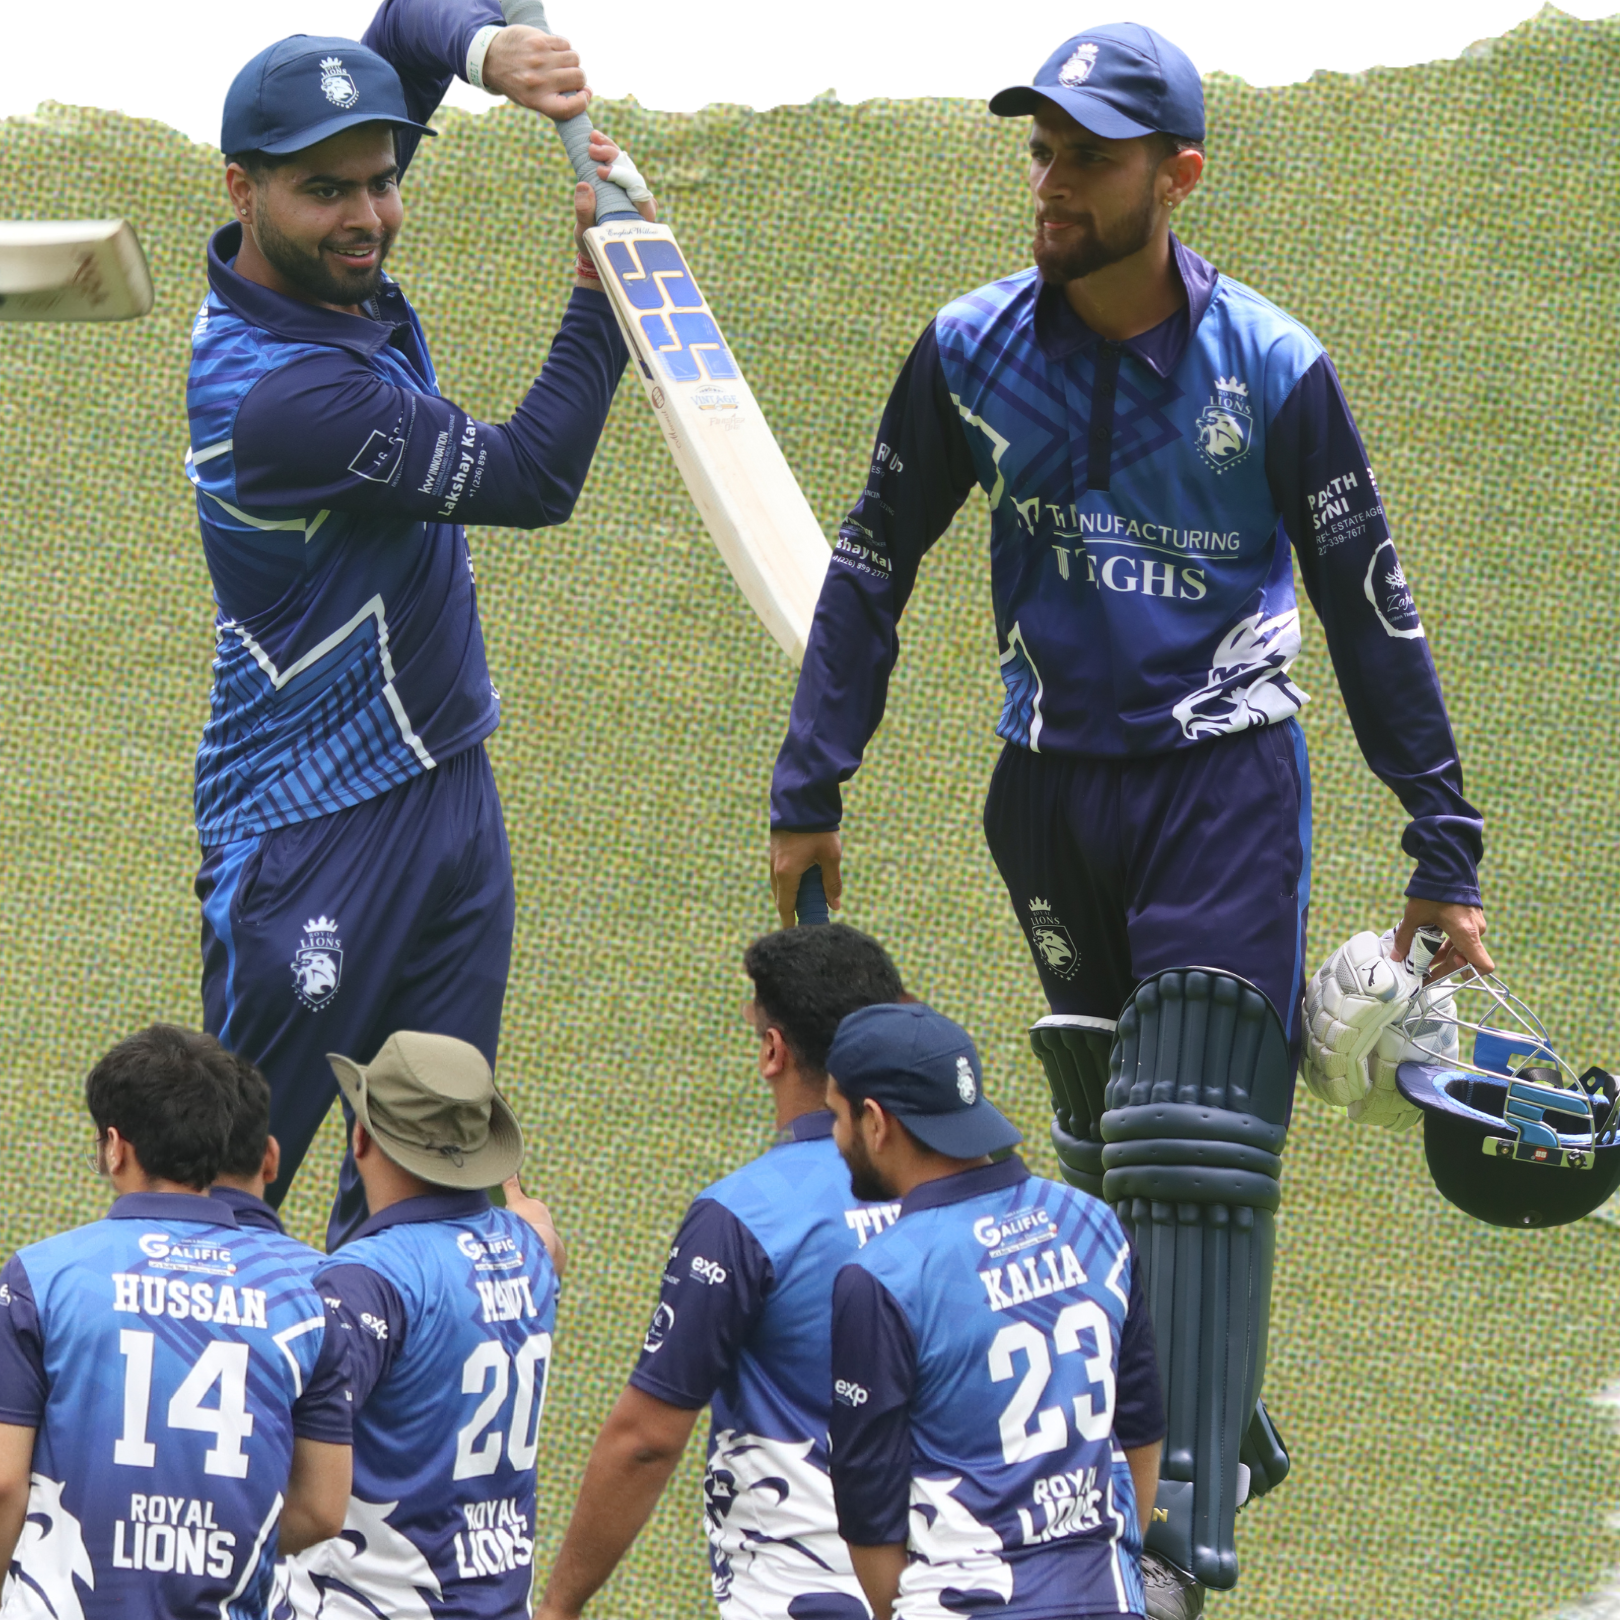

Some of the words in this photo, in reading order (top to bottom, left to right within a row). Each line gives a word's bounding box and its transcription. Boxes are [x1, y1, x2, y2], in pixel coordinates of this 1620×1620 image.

[690, 395, 739, 406] VINTAGE
[1210, 395, 1251, 414] LIONS
[429, 430, 449, 477] INNOVATION
[437, 451, 475, 516] Lakshay
[1331, 514, 1365, 534] ESTATE
[1365, 506, 1383, 520] AGE
[1030, 914, 1060, 926] LIONS
[300, 937, 341, 949] LIONS
[138, 1233, 232, 1263] GALIFIC
[973, 1210, 1050, 1248] GALIFIC
[690, 1256, 727, 1285] exp
[979, 1244, 1089, 1312] KALIA
[112, 1272, 268, 1329] HUSSAN
[834, 1379, 869, 1407] exp
[988, 1300, 1117, 1465] 23
[113, 1328, 254, 1479] 14
[452, 1331, 552, 1482] 20
[130, 1493, 218, 1531] ROYAL
[463, 1497, 529, 1531] ROYAL
[112, 1519, 236, 1580] LIONS
[453, 1524, 534, 1580] LIONS
